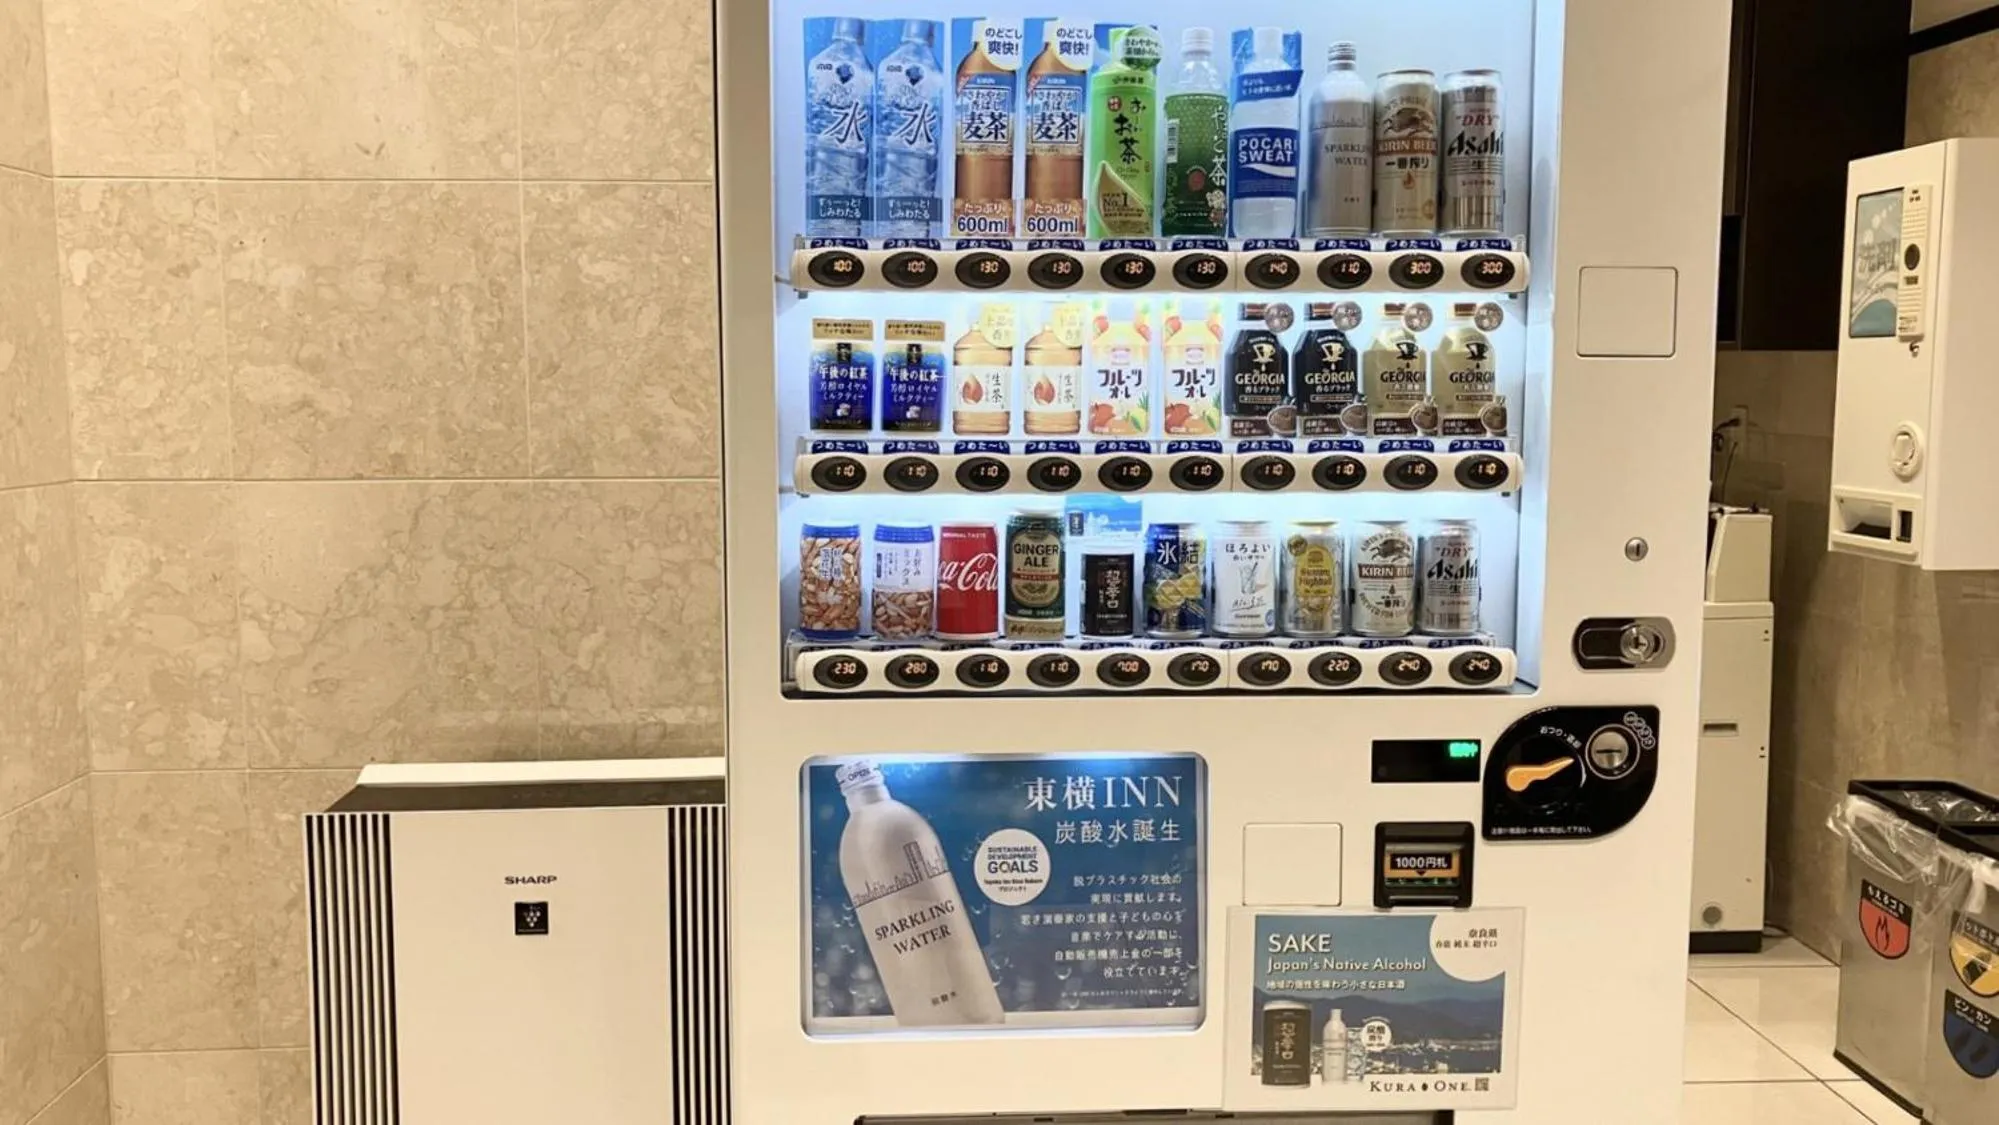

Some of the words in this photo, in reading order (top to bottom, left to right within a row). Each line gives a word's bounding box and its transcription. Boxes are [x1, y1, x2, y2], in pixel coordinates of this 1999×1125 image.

[824, 101, 867, 144] 水
[894, 102, 937, 146] 水
[963, 112, 1008, 140] 麦茶
[1035, 112, 1078, 140] 麦茶
[1238, 138, 1297, 151] POCARI
[1447, 130, 1503, 156] Asahi
[1238, 151, 1293, 163] SWEAT
[957, 217, 1008, 233] 600ml
[1027, 217, 1078, 233] 600ml
[834, 260, 853, 272] 100
[908, 260, 925, 273] 100
[980, 261, 998, 273] 130
[1053, 261, 1071, 273] 130
[1125, 262, 1144, 273] 130
[1197, 262, 1216, 273] 130
[1269, 262, 1288, 273] 140
[1341, 262, 1360, 274] 110
[1409, 262, 1431, 274] 300
[1482, 262, 1503, 274] 300
[820, 366, 868, 380] 午後の紅茶
[890, 367, 938, 382] 午後の紅茶
[1097, 369, 1142, 386] フルーツ
[1172, 369, 1216, 386] フルーツ
[1235, 372, 1286, 385] GEORGIA
[1304, 371, 1355, 385] GEORGIA
[991, 372, 1002, 403] 生茶
[836, 465, 855, 477] 110
[908, 465, 926, 477] 110
[980, 465, 999, 477] 110
[1051, 465, 1070, 477] 110
[1122, 465, 1140, 476] 110
[1193, 465, 1212, 476] 110
[1264, 464, 1283, 475] 110
[1336, 464, 1355, 475] 110
[1407, 464, 1426, 475] 110
[1478, 463, 1497, 475] 110
[1014, 543, 1059, 555] GINGER
[1157, 541, 1200, 565] 氷結
[1225, 543, 1271, 553] ほろよい
[1024, 557, 1048, 567] ALE
[1361, 567, 1394, 577] KIRIN
[1427, 559, 1478, 579] Asahi
[834, 662, 855, 674] 230
[905, 662, 926, 674] 280
[980, 662, 998, 673] 110
[1050, 661, 1068, 672] 110
[1118, 661, 1139, 672] 700
[1191, 661, 1209, 672] 170
[1261, 660, 1279, 671] 170
[1328, 660, 1350, 671] 220
[1399, 659, 1420, 671] 240
[1468, 659, 1490, 671] 240
[1024, 776, 1182, 812] 東横INN
[1055, 819, 1180, 844] 炭酸水誕生
[988, 860, 1039, 873] GOALS
[1396, 856, 1448, 869] 1000円札
[504, 875, 558, 885] SHARP
[874, 900, 955, 941] SPARKLING
[893, 924, 952, 955] WATER
[1268, 932, 1332, 953] SAKE
[1267, 957, 1320, 973] Japan's
[1323, 958, 1369, 971] Native
[1373, 957, 1426, 971] Alcohol
